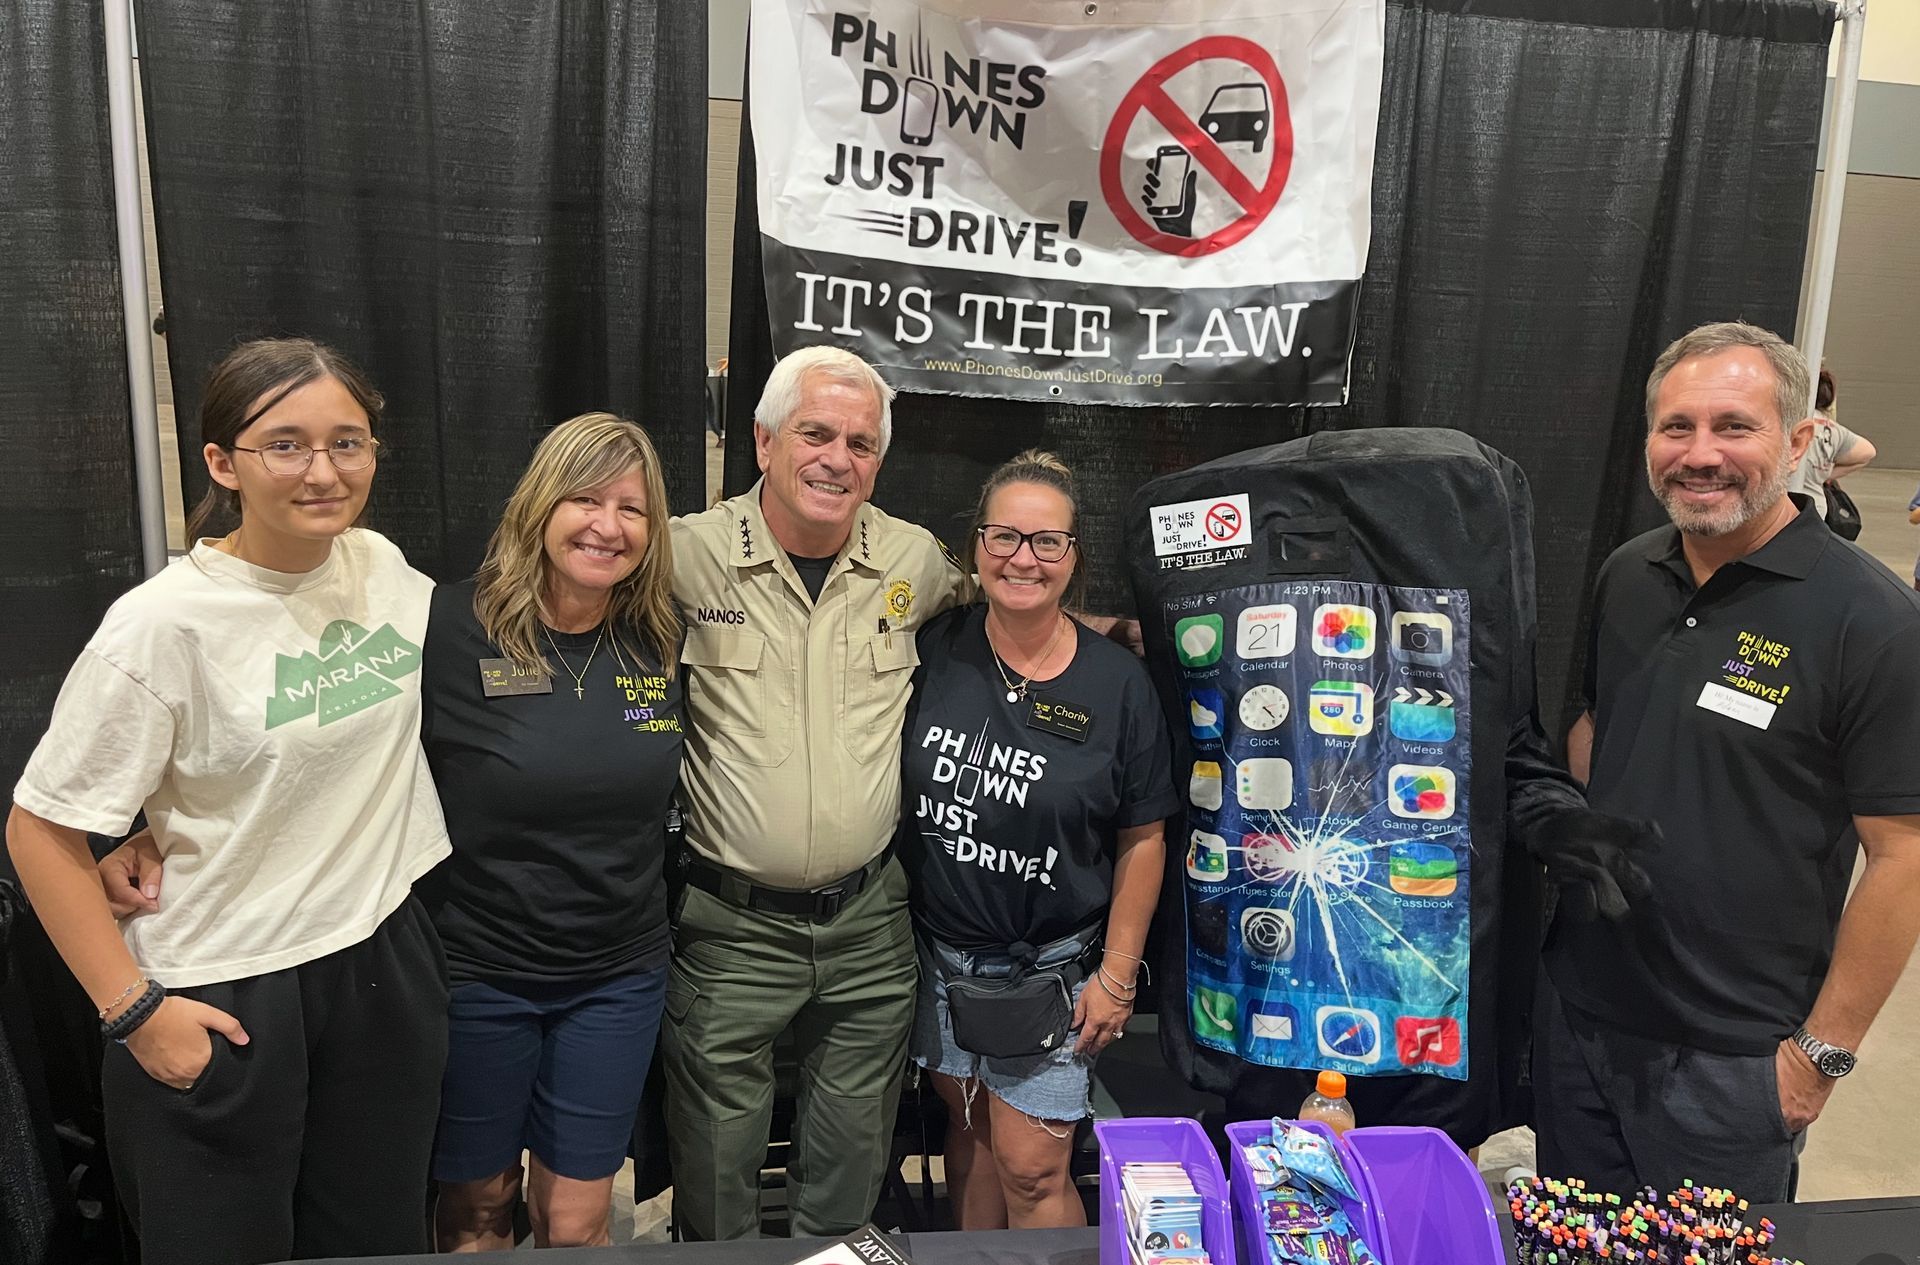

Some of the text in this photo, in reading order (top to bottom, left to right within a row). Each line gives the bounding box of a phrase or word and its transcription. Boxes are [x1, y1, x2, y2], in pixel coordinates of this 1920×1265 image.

[824, 143, 945, 199] JUST
[909, 201, 1089, 268] DRIVE!
[794, 272, 1314, 360] IT'S THE LAW.
[1165, 520, 1194, 533] DWN
[1162, 534, 1182, 544] JUST
[1176, 534, 1207, 550] DRIVE!
[1160, 547, 1247, 569] IT'S THE LAW.
[1283, 585, 1331, 595] 4:23 PM
[1166, 598, 1201, 611] No SIM
[697, 607, 746, 625] NANOS
[1246, 611, 1288, 622] Saturday
[1247, 623, 1281, 651] 21
[1240, 660, 1289, 672] Calendar
[1322, 659, 1365, 672] Photos
[1400, 666, 1446, 679] Camera
[1722, 659, 1754, 677] JUST
[283, 645, 413, 703] MARANA
[1735, 676, 1790, 705] DRIVE!
[325, 687, 387, 715] ARIZONA
[623, 708, 655, 722] JUST
[1054, 705, 1090, 725] Charity
[1323, 706, 1342, 714] 280
[1249, 737, 1280, 747] Clock
[1324, 738, 1358, 749] Maps
[1402, 743, 1444, 755] Videos
[916, 794, 978, 835] JUST
[1240, 812, 1293, 822] Remins
[1382, 819, 1463, 833] Game Center
[956, 835, 1059, 886] DRIVE!
[1238, 886, 1295, 898] iTunes Stor
[1393, 896, 1454, 909] Passbook
[1250, 960, 1292, 976] Settings
[1261, 1053, 1284, 1065] Mail
